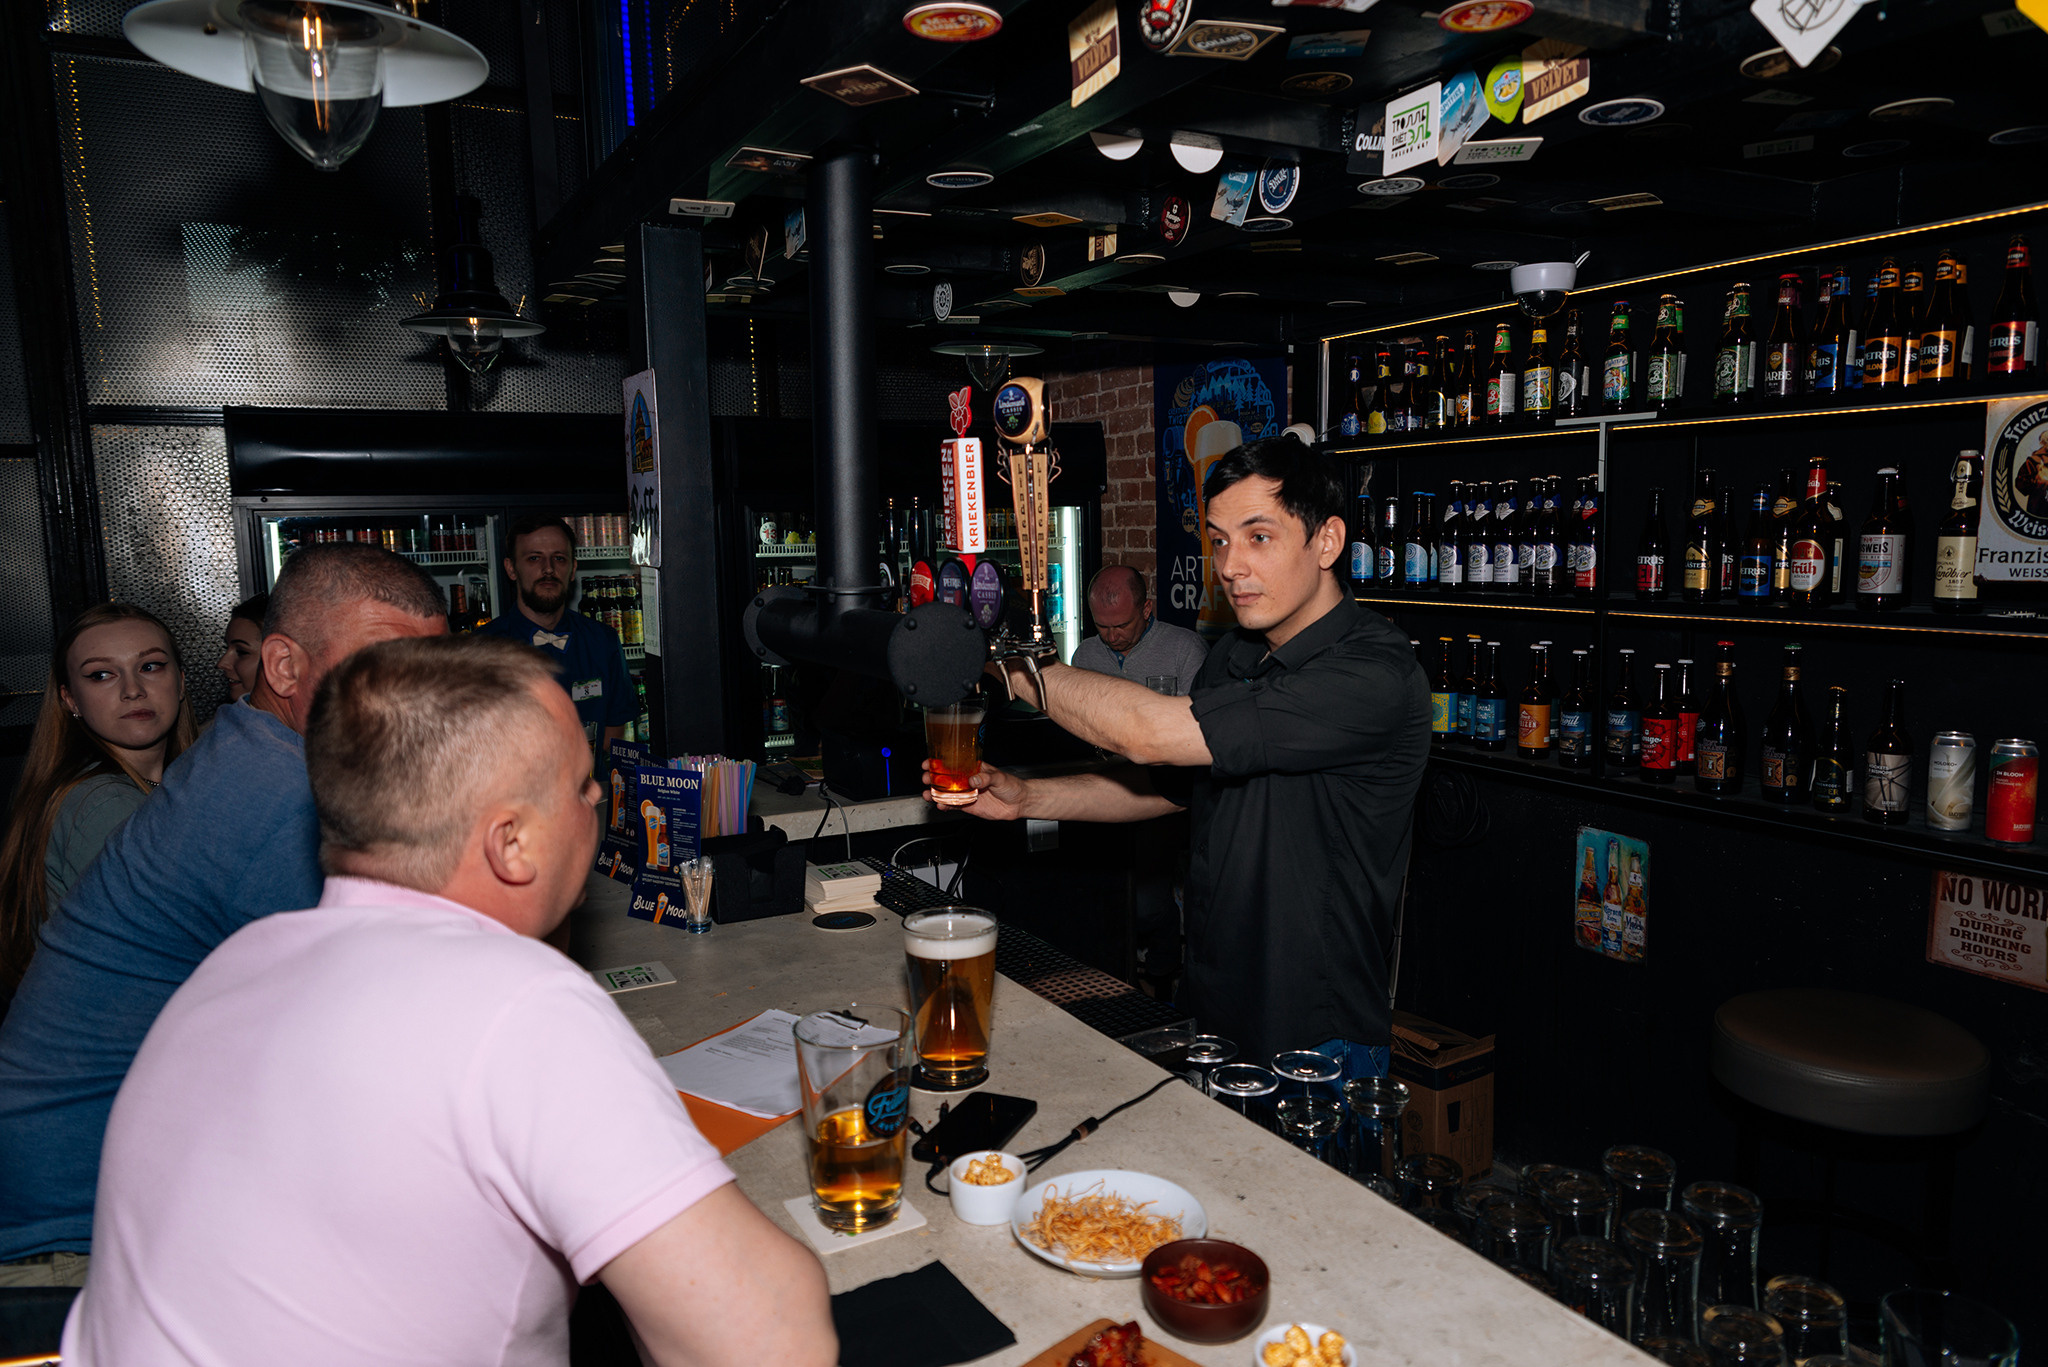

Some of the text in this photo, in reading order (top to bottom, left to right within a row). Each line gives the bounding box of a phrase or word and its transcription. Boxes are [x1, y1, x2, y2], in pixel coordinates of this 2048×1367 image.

[1077, 37, 1112, 81] VELVET
[1532, 59, 1580, 101] VELVET
[1355, 132, 1385, 152] COLLIN
[1864, 350, 1896, 361] ETRUS
[1920, 344, 1949, 356] ETRUS
[1765, 370, 1792, 381] ARBE
[2004, 406, 2048, 443] Franz
[965, 443, 979, 547] KRIEKENBIER
[1017, 463, 1031, 582] Lindemans
[1037, 463, 1045, 582] Lindemans
[2008, 509, 2048, 536] Weis
[1637, 555, 1664, 565] ETRUS
[1978, 547, 2048, 564] Franzis
[1170, 555, 1216, 582] ARTF
[1740, 567, 1766, 576] ETRUS
[1792, 561, 1816, 575] früh
[2009, 568, 2048, 578] WEISS
[1170, 583, 1224, 611] CRAF
[612, 745, 626, 757] BLUE
[640, 774, 699, 790] BLUE MOON
[598, 852, 613, 867] BLUE
[1940, 878, 1973, 905] NO
[633, 895, 655, 911] BLUE
[1959, 917, 2024, 940] DURING
[1950, 927, 2032, 954] DRINKING
[1961, 941, 2017, 963] HOURS
